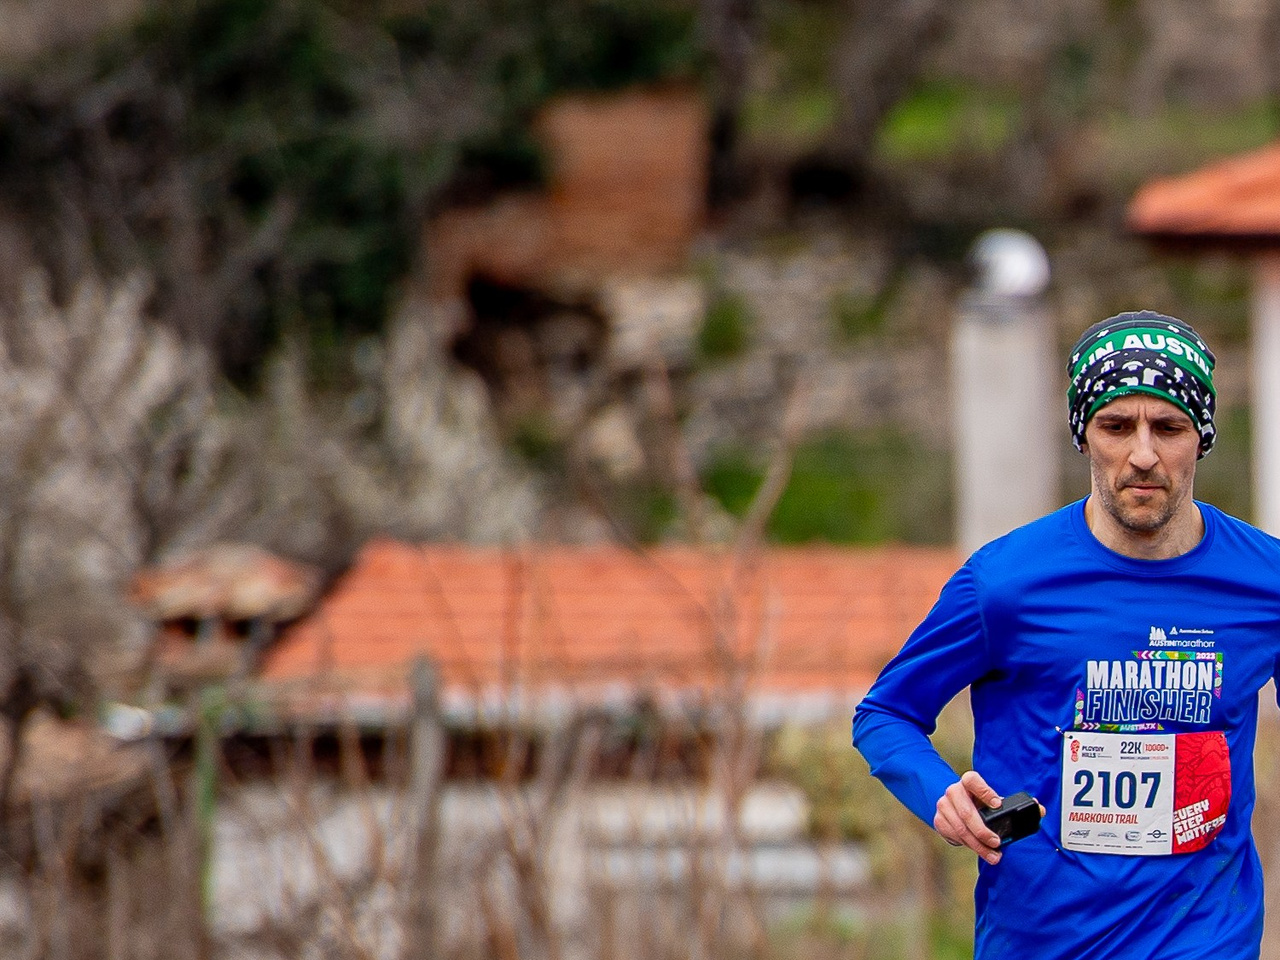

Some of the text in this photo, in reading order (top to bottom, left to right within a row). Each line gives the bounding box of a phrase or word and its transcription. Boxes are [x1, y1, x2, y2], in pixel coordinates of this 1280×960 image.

[1086, 660, 1213, 690] MARATHON
[1086, 688, 1213, 724] FINISHER
[1120, 741, 1142, 754] 22K
[1072, 769, 1162, 809] 2107
[1069, 812, 1139, 825] MARKOVO TRAIL
[1173, 813, 1204, 835] STEP
